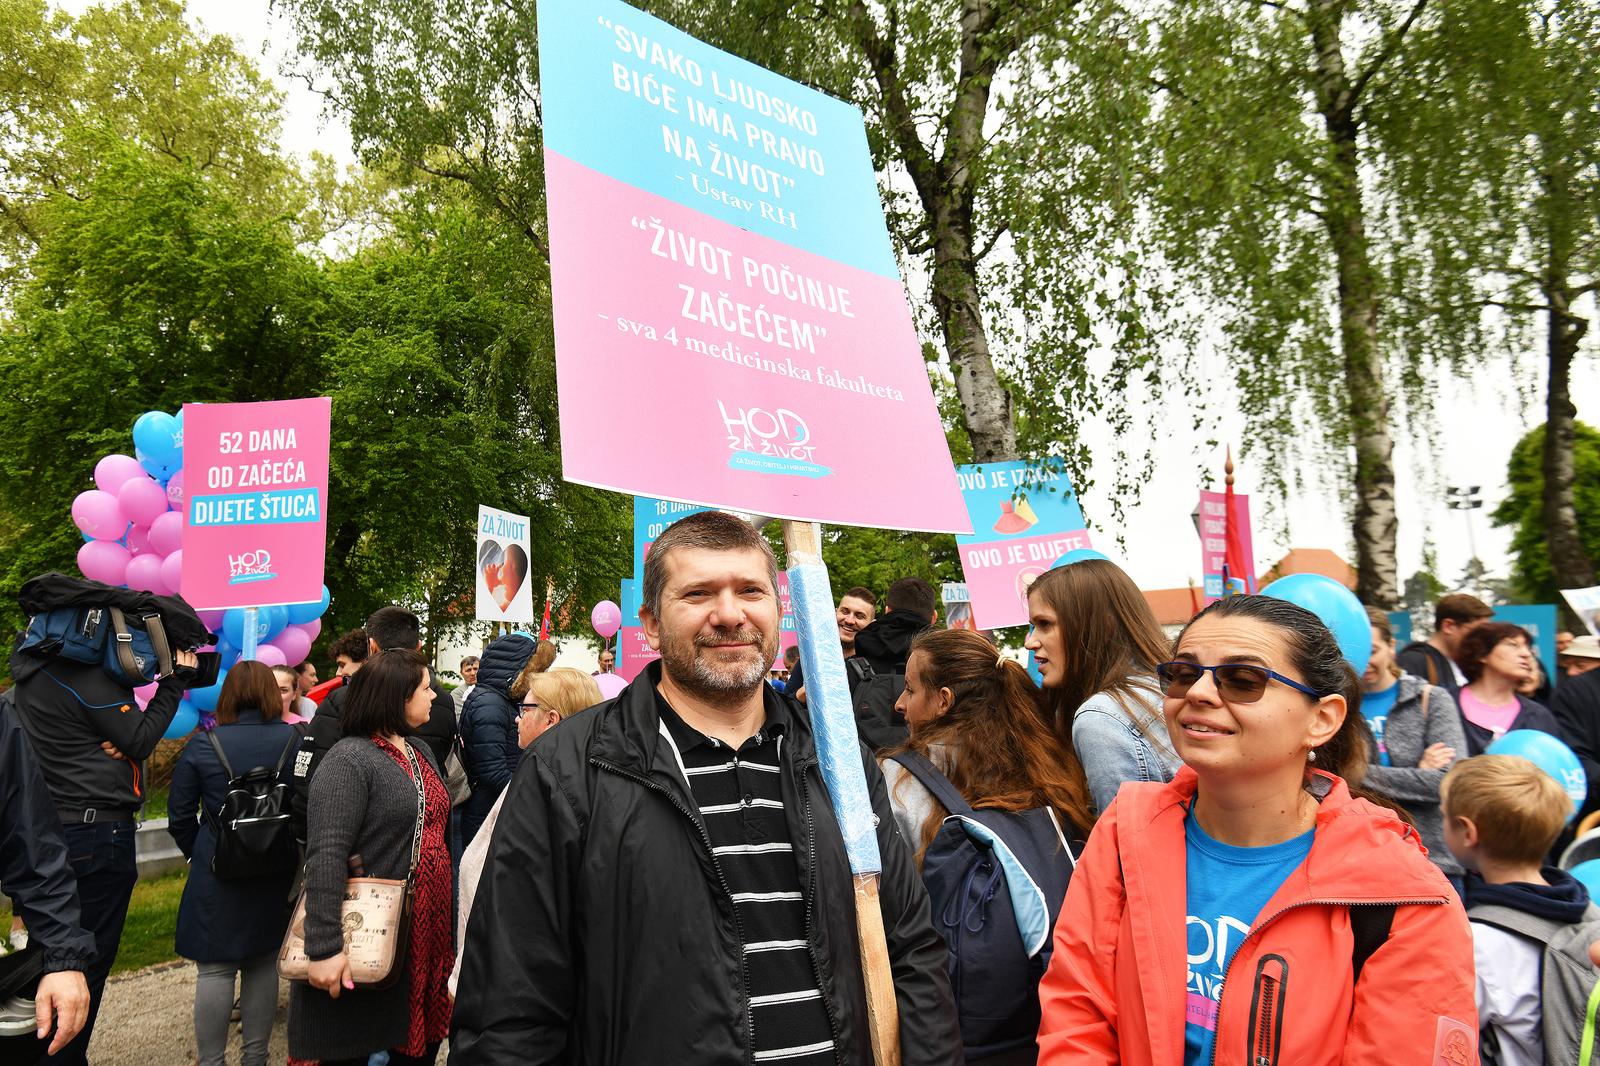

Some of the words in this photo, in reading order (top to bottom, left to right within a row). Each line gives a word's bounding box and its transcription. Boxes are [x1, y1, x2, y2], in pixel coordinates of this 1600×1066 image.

[597, 15, 701, 87] “SVAKO
[711, 70, 818, 137] LJUDSKO
[612, 61, 678, 116] BIĆE
[688, 94, 738, 141] IMA
[746, 121, 825, 177] PRAVO
[661, 125, 701, 168] NA
[691, 172, 754, 213] Ustav
[760, 200, 799, 231] RH
[631, 216, 732, 281] “ŽIVOT
[743, 256, 855, 319] POČINJE
[616, 317, 659, 342] sva
[663, 327, 679, 346] 4
[684, 335, 813, 382] medicinska
[816, 365, 904, 402] fakulteta
[717, 399, 810, 446] HOD
[219, 431, 242, 454] 52
[249, 428, 297, 452] DANA
[727, 432, 755, 451] ZA
[760, 439, 817, 464] ŽIVOT
[208, 466, 233, 489] OD
[239, 457, 306, 487] ZAČEĆA
[956, 472, 986, 491] OVO
[990, 470, 1009, 489] JE
[195, 498, 254, 523] DIJETE
[259, 493, 316, 519] ŠTUCA
[655, 500, 668, 515] 18
[482, 513, 495, 534] ZA
[497, 514, 525, 541] ŽIVOT
[648, 523, 663, 539] OD
[228, 549, 271, 571] HOD
[968, 548, 1002, 569] OVO
[1007, 544, 1029, 565] JE
[944, 588, 956, 600] ZA
[956, 585, 969, 600] ŽIV
